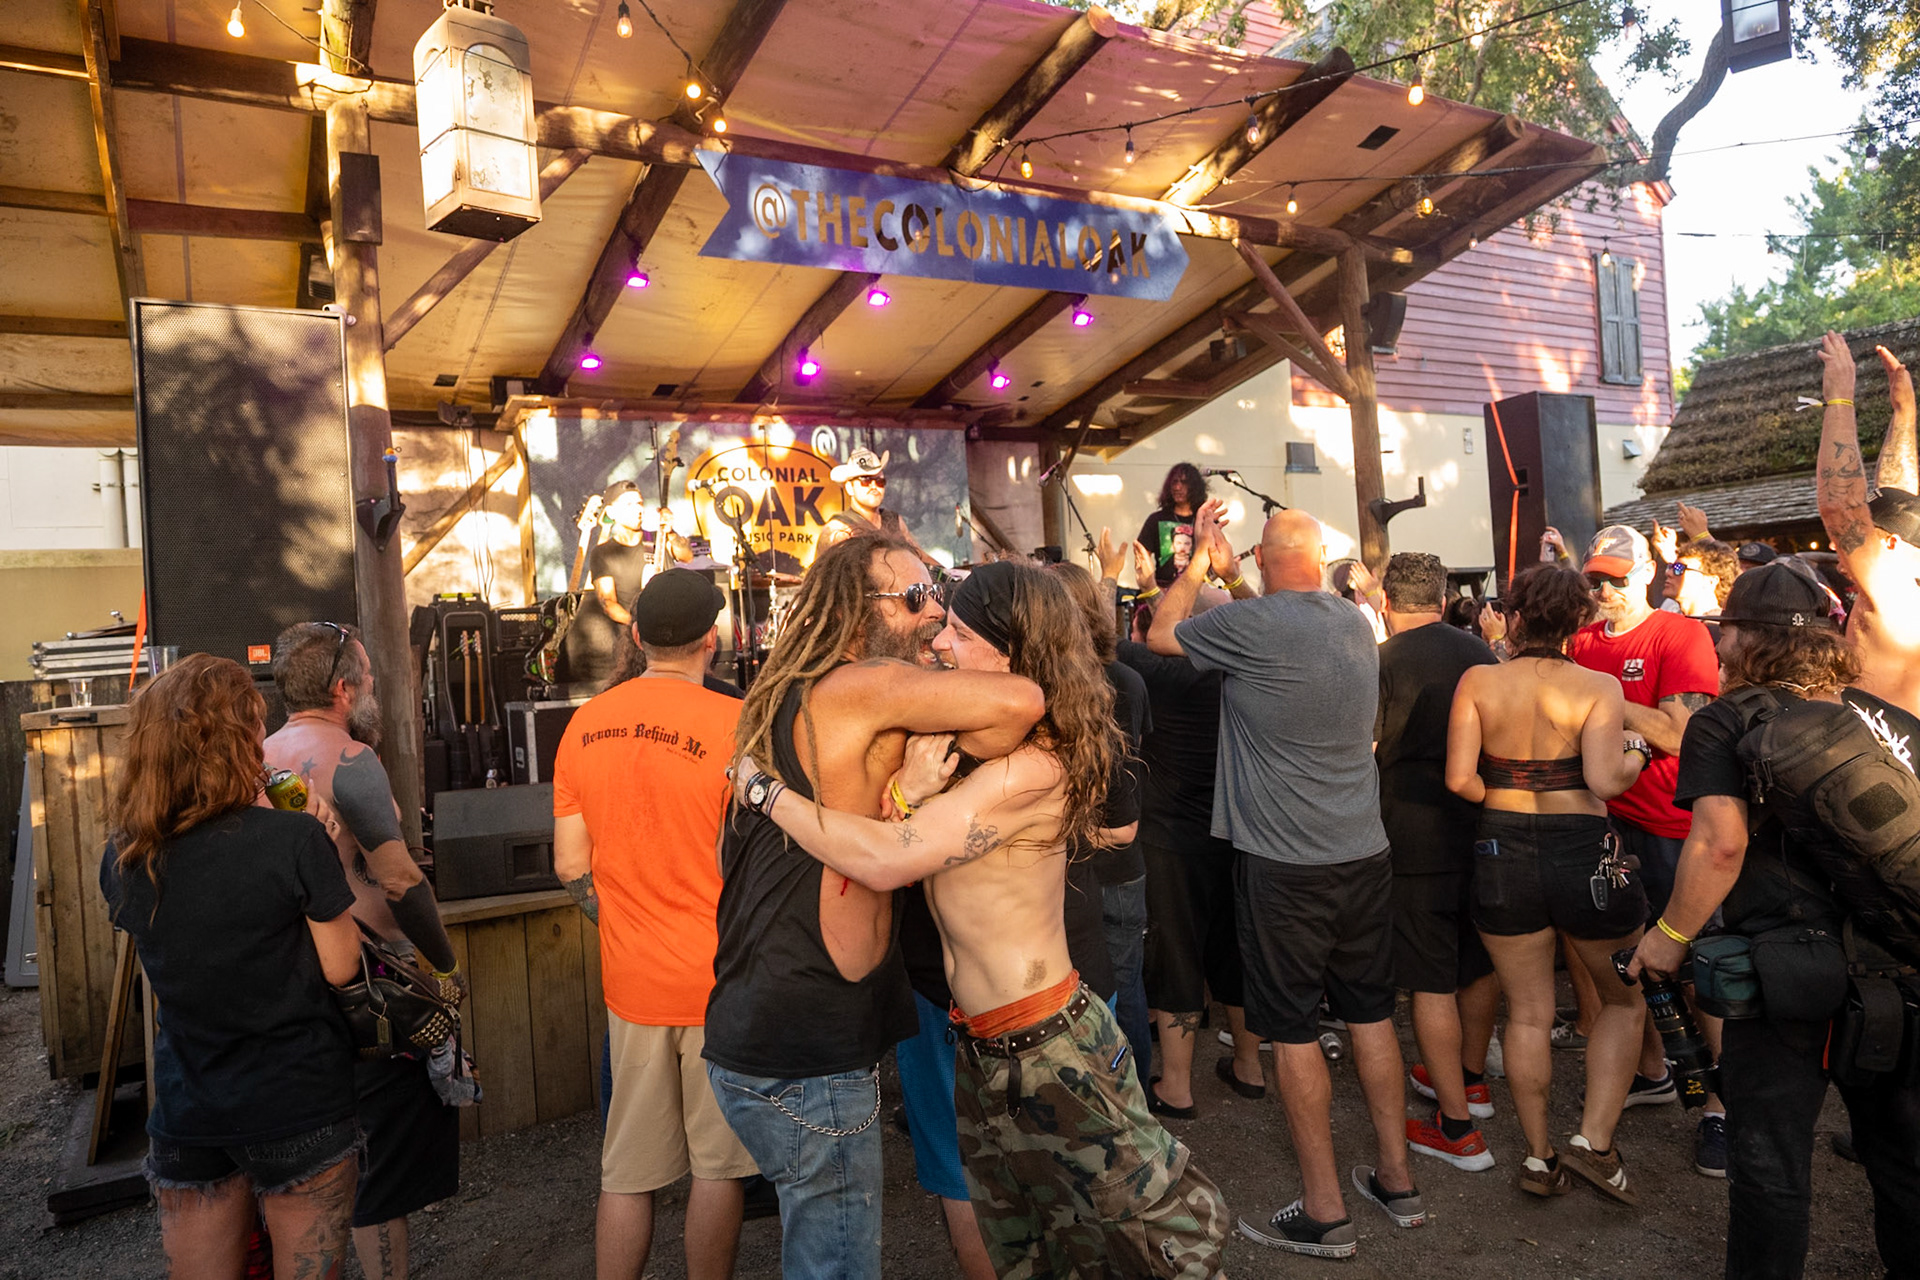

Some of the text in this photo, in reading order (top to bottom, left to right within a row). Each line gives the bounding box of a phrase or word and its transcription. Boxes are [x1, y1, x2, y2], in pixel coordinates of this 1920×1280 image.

[754, 183, 1151, 279] @THECOLONIALOAK
[717, 467, 820, 483] COLONIAL
[714, 486, 826, 527] OAK
[779, 532, 812, 545] PARK
[633, 722, 680, 745] Behind
[682, 736, 707, 759] Me
